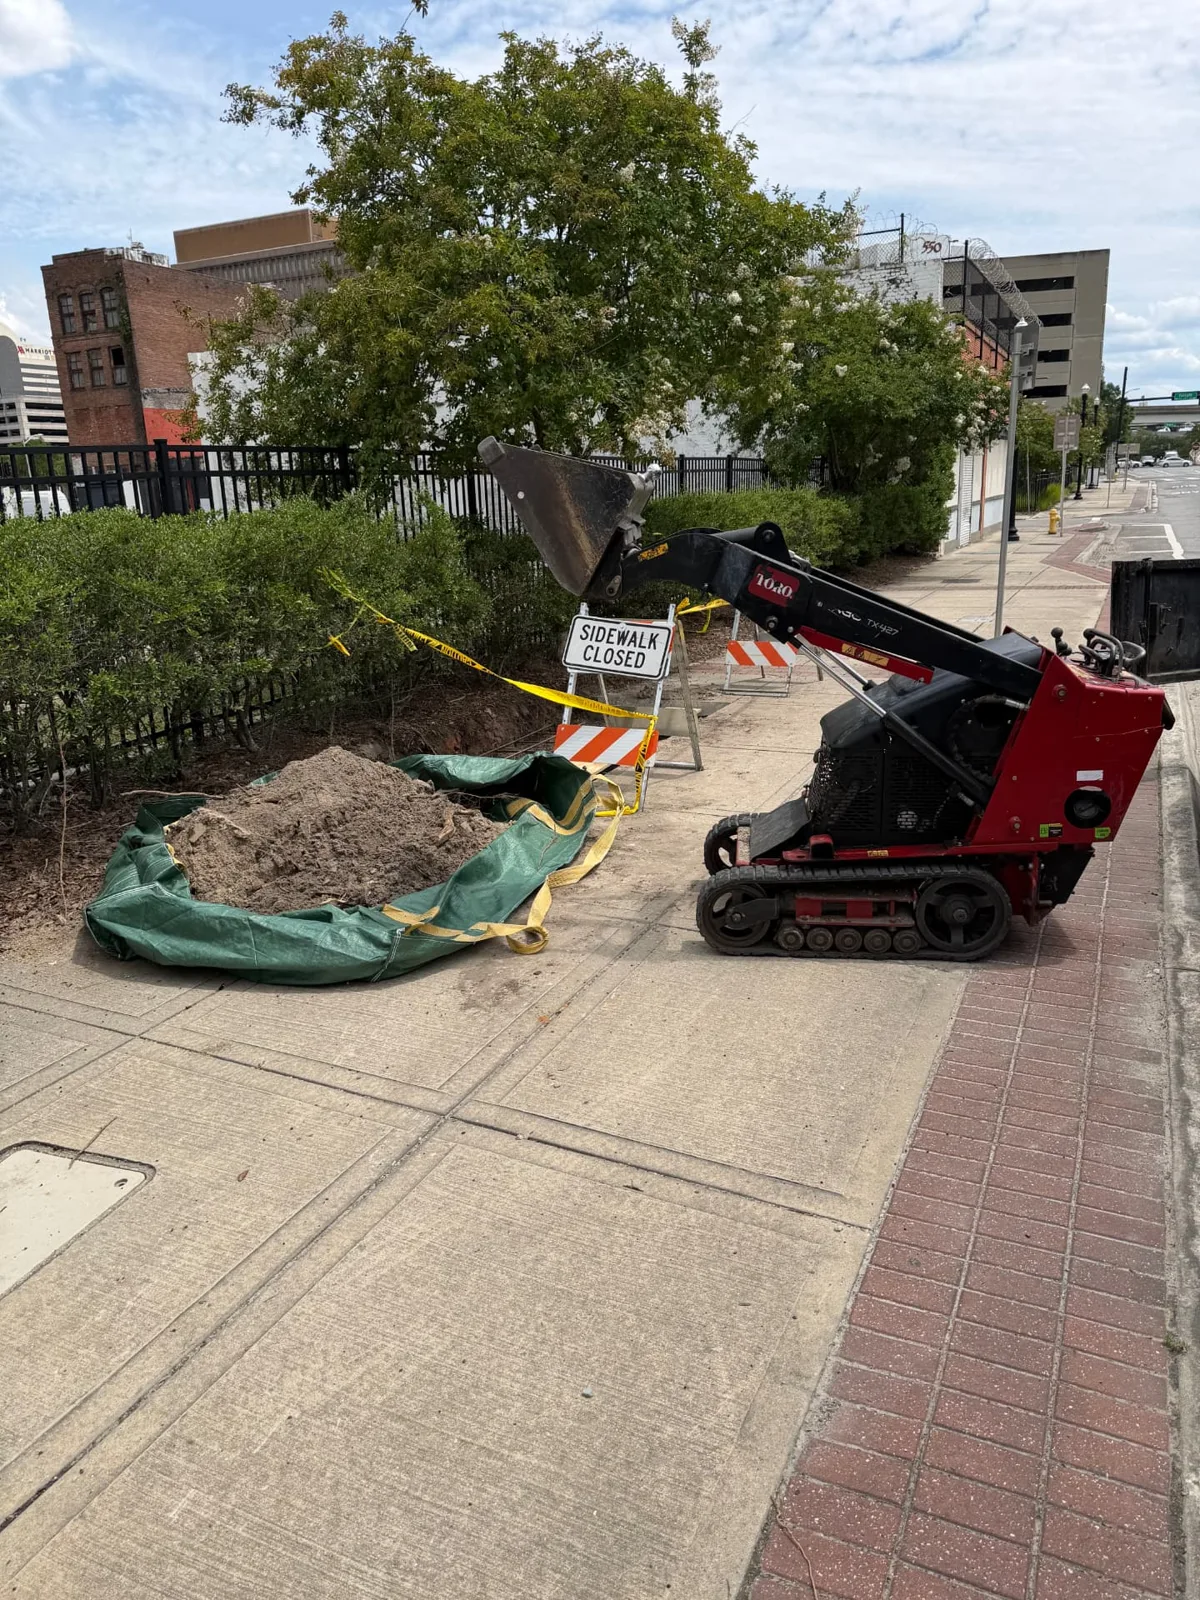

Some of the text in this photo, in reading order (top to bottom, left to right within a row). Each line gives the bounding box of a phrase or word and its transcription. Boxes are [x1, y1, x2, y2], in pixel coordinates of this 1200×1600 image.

[921, 241, 942, 254] 550
[756, 573, 793, 600] TORO
[579, 624, 660, 650] SIDEWALK
[583, 645, 646, 669] CLOSED
